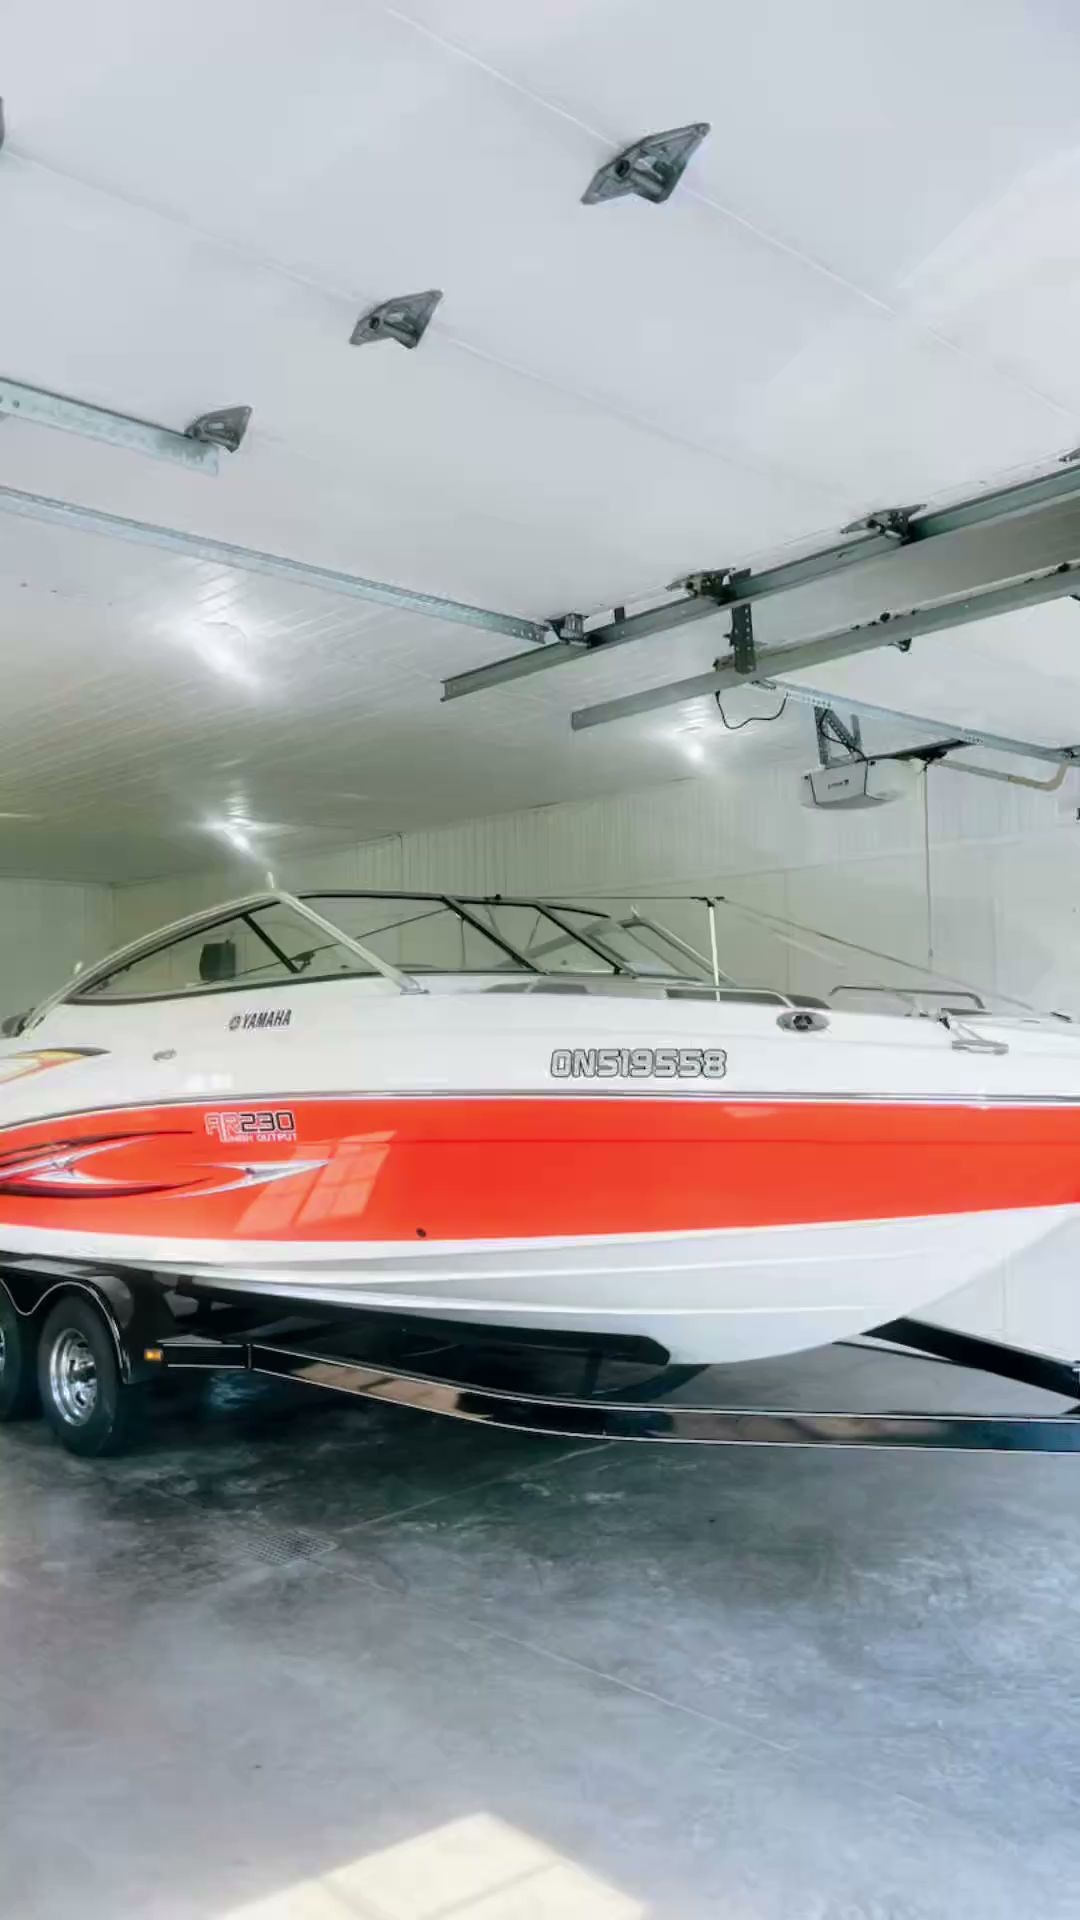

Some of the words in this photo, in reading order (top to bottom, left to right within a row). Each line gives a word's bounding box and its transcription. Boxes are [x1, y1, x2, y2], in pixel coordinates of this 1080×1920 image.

[242, 1009, 292, 1029] YAMAHA
[551, 1049, 727, 1078] ON519558
[256, 1133, 297, 1142] OUTPUT
